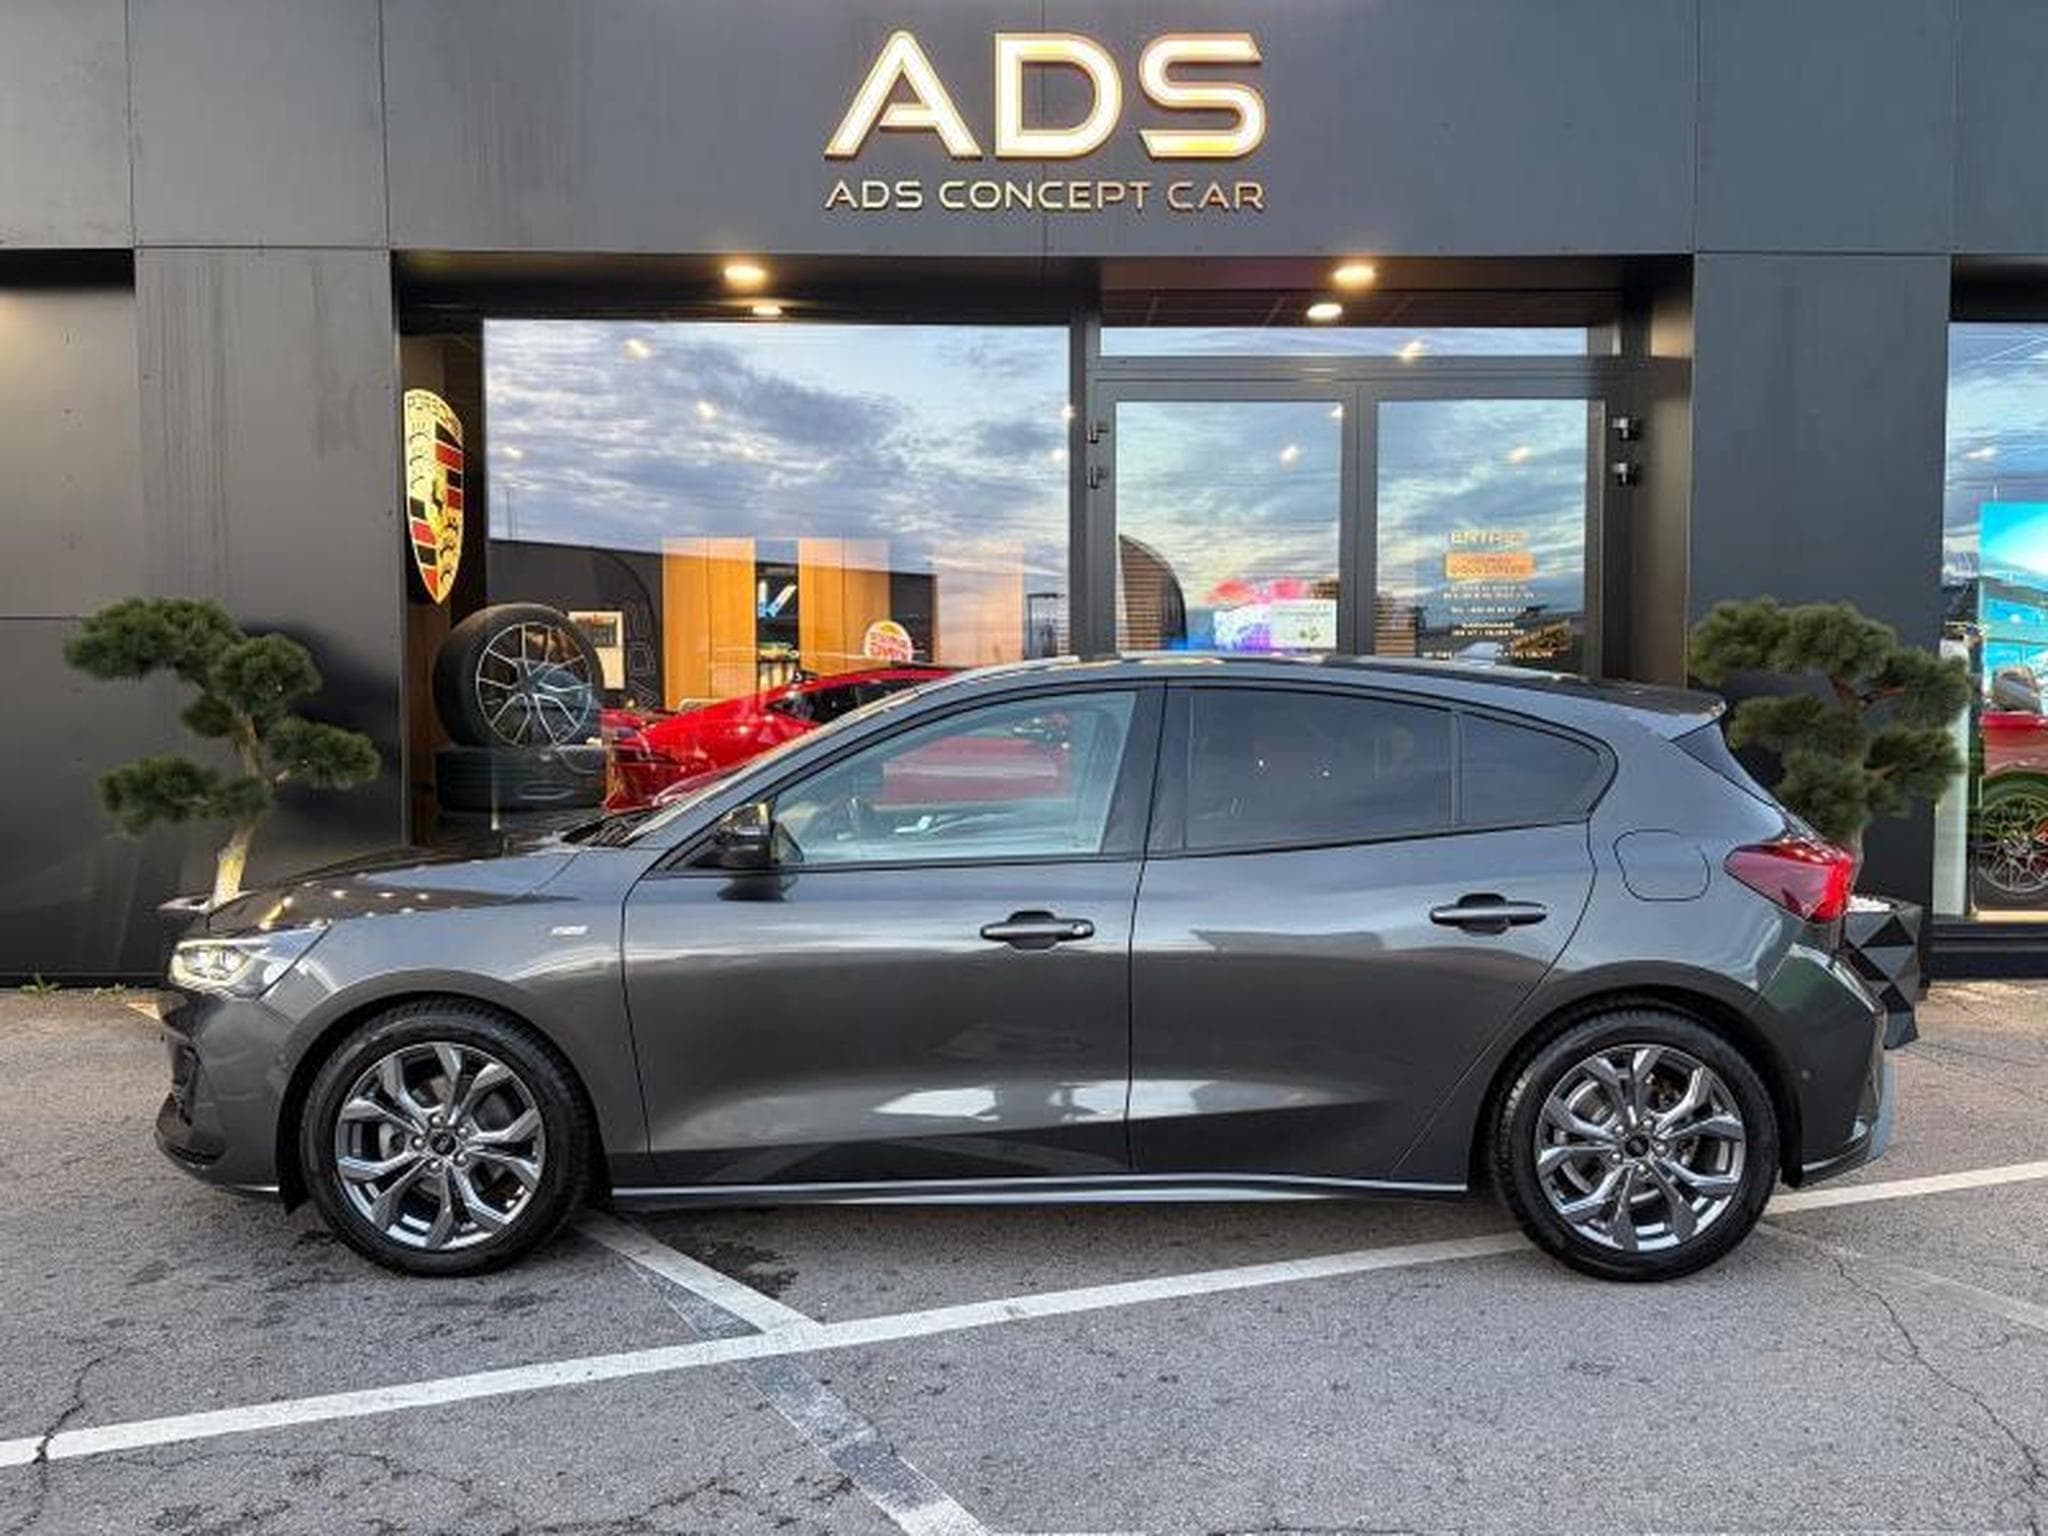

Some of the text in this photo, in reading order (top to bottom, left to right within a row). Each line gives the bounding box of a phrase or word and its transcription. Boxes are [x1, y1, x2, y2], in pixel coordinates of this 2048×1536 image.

[824, 29, 1267, 160] ADS
[825, 180, 1265, 211] ADS CONCEPT CAR
